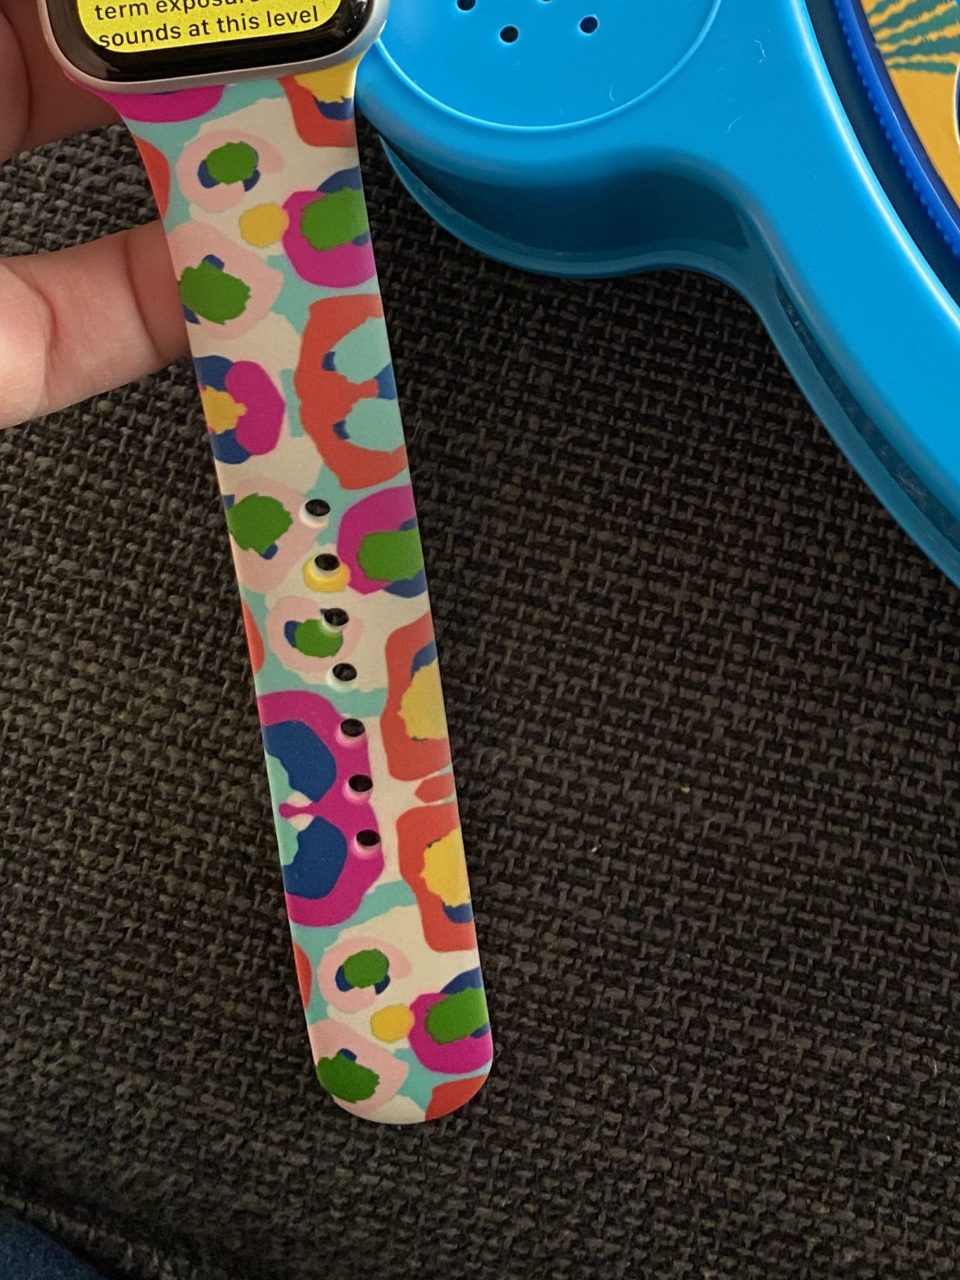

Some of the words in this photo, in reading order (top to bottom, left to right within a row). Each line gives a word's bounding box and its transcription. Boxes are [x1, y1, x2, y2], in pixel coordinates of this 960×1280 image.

[94, 2, 149, 21] term
[98, 27, 181, 49] sounds
[188, 22, 210, 38] at
[217, 13, 260, 33] this
[266, 5, 319, 25] level
